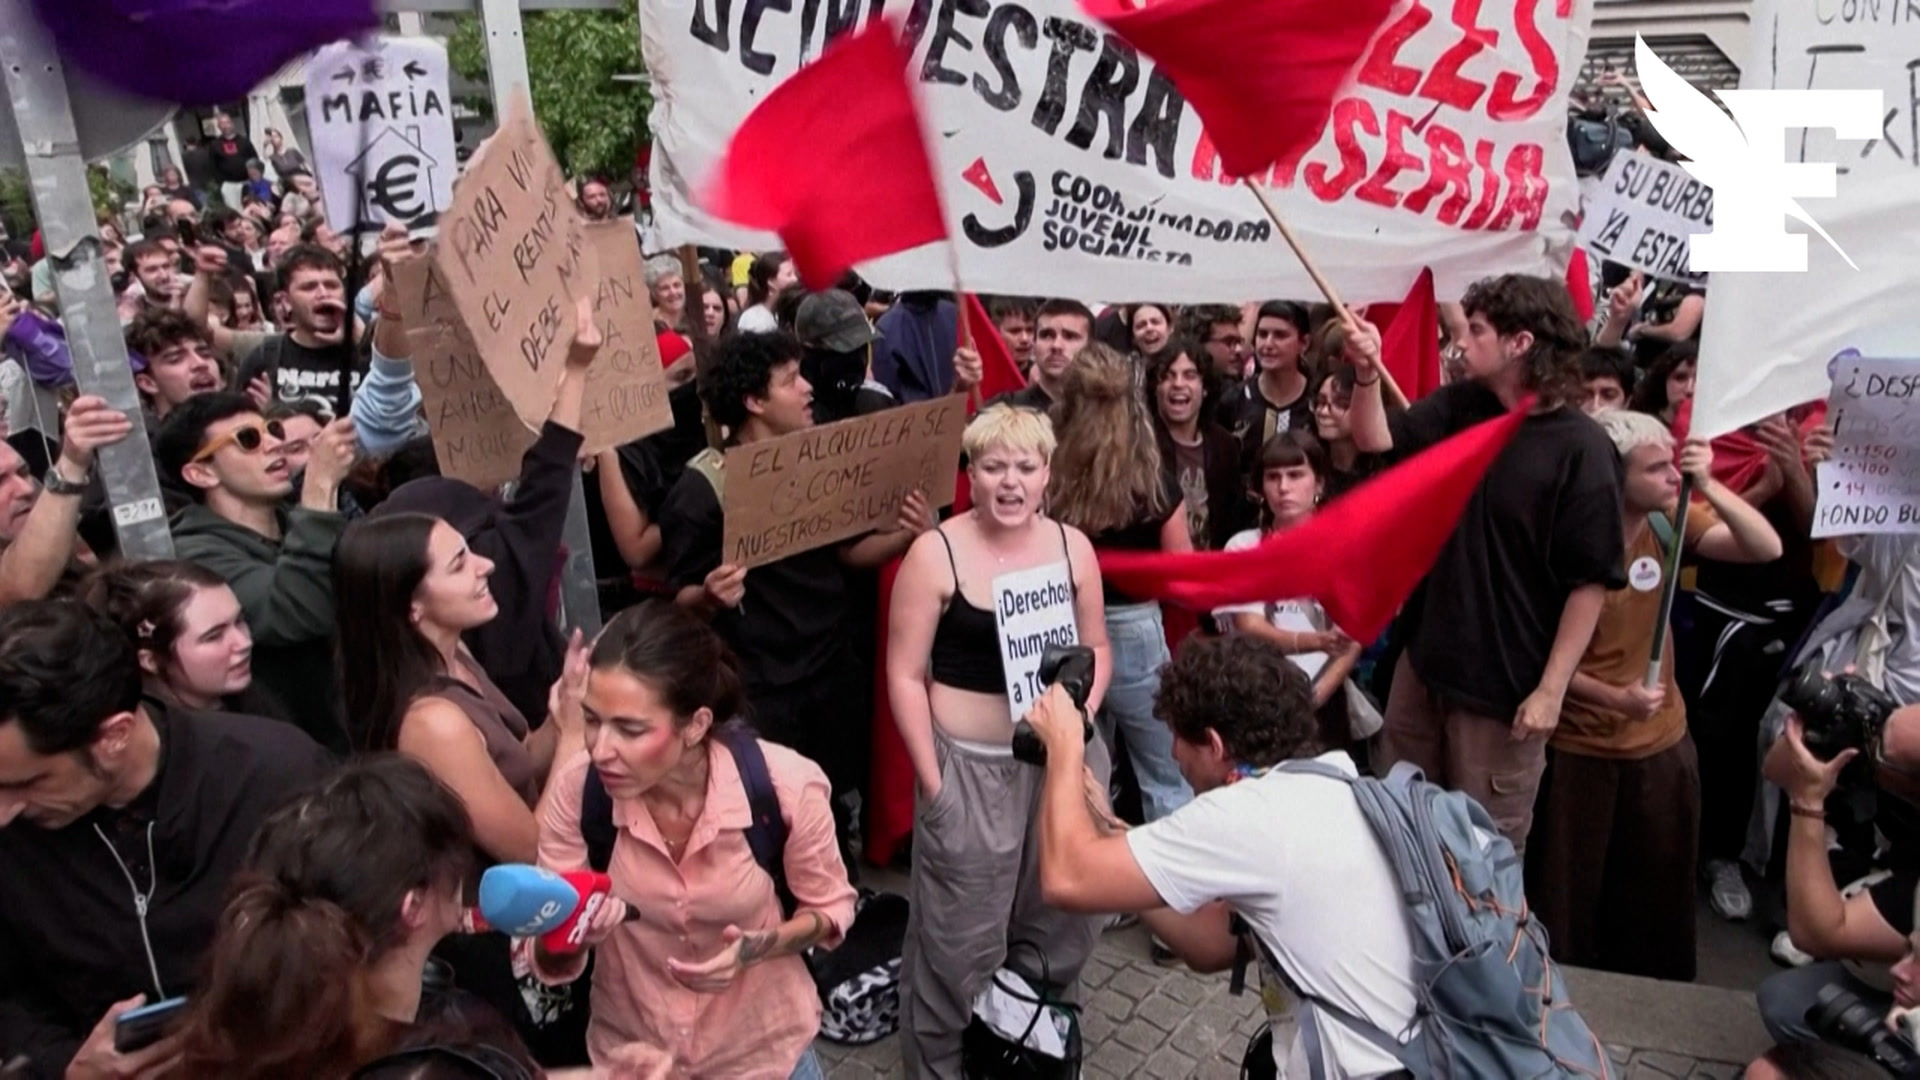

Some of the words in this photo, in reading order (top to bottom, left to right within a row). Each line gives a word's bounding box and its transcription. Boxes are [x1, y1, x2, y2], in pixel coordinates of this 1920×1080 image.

[1192, 97, 1549, 232] SERIA
[1615, 158, 1652, 199] SU
[451, 186, 508, 286] PARA
[1044, 198, 1153, 249] JUVENIL
[1596, 207, 1630, 249] YA
[483, 290, 510, 333] EL
[514, 180, 559, 287] RENTIS
[520, 295, 564, 373] DEBE
[750, 449, 784, 478] EL
[797, 417, 916, 464] ALQUILER
[922, 407, 950, 438] SE
[735, 510, 833, 560] NUESTROS
[1012, 681, 1022, 704] a
